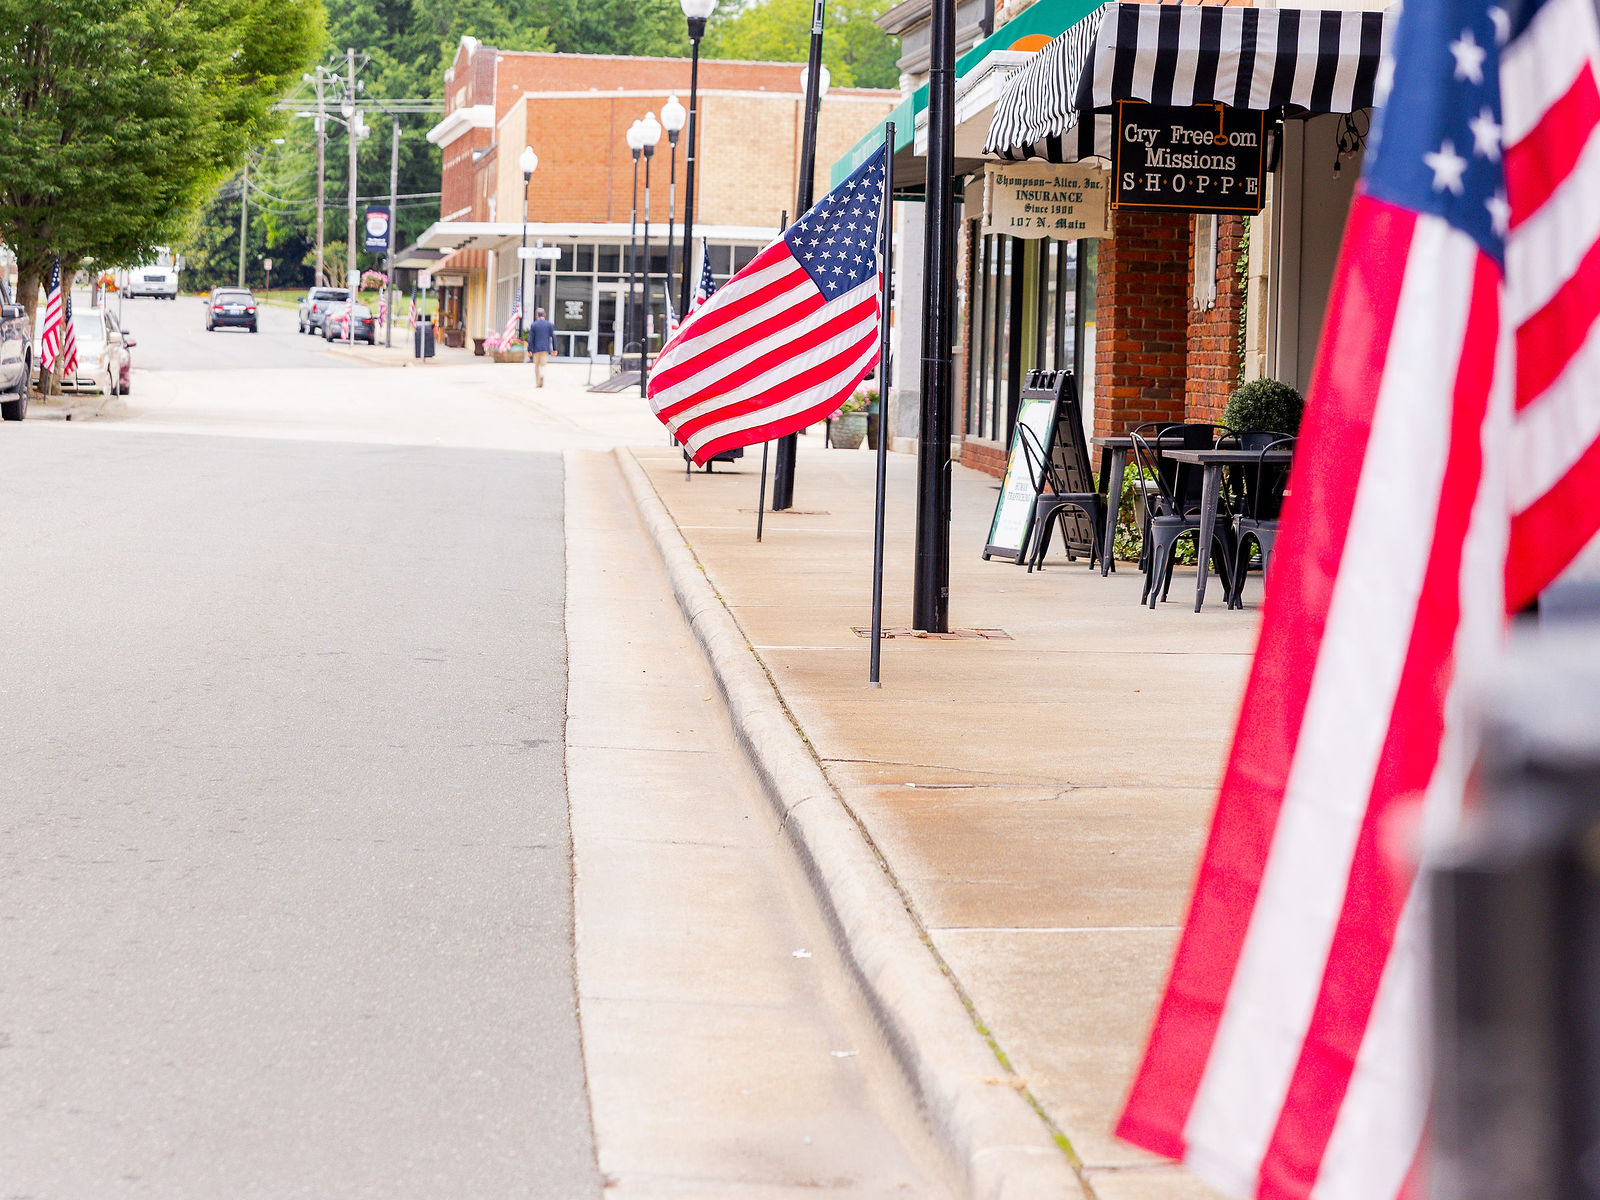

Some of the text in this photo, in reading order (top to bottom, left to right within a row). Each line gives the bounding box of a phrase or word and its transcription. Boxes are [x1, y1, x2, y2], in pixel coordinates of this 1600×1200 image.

[1124, 123, 1161, 148] Cry
[1144, 147, 1236, 171] Missions
[1083, 177, 1104, 190] Inc.
[1015, 190, 1084, 203] INSURANCE
[1024, 203, 1049, 214] Since
[1010, 216, 1087, 230] 107 N. Main
